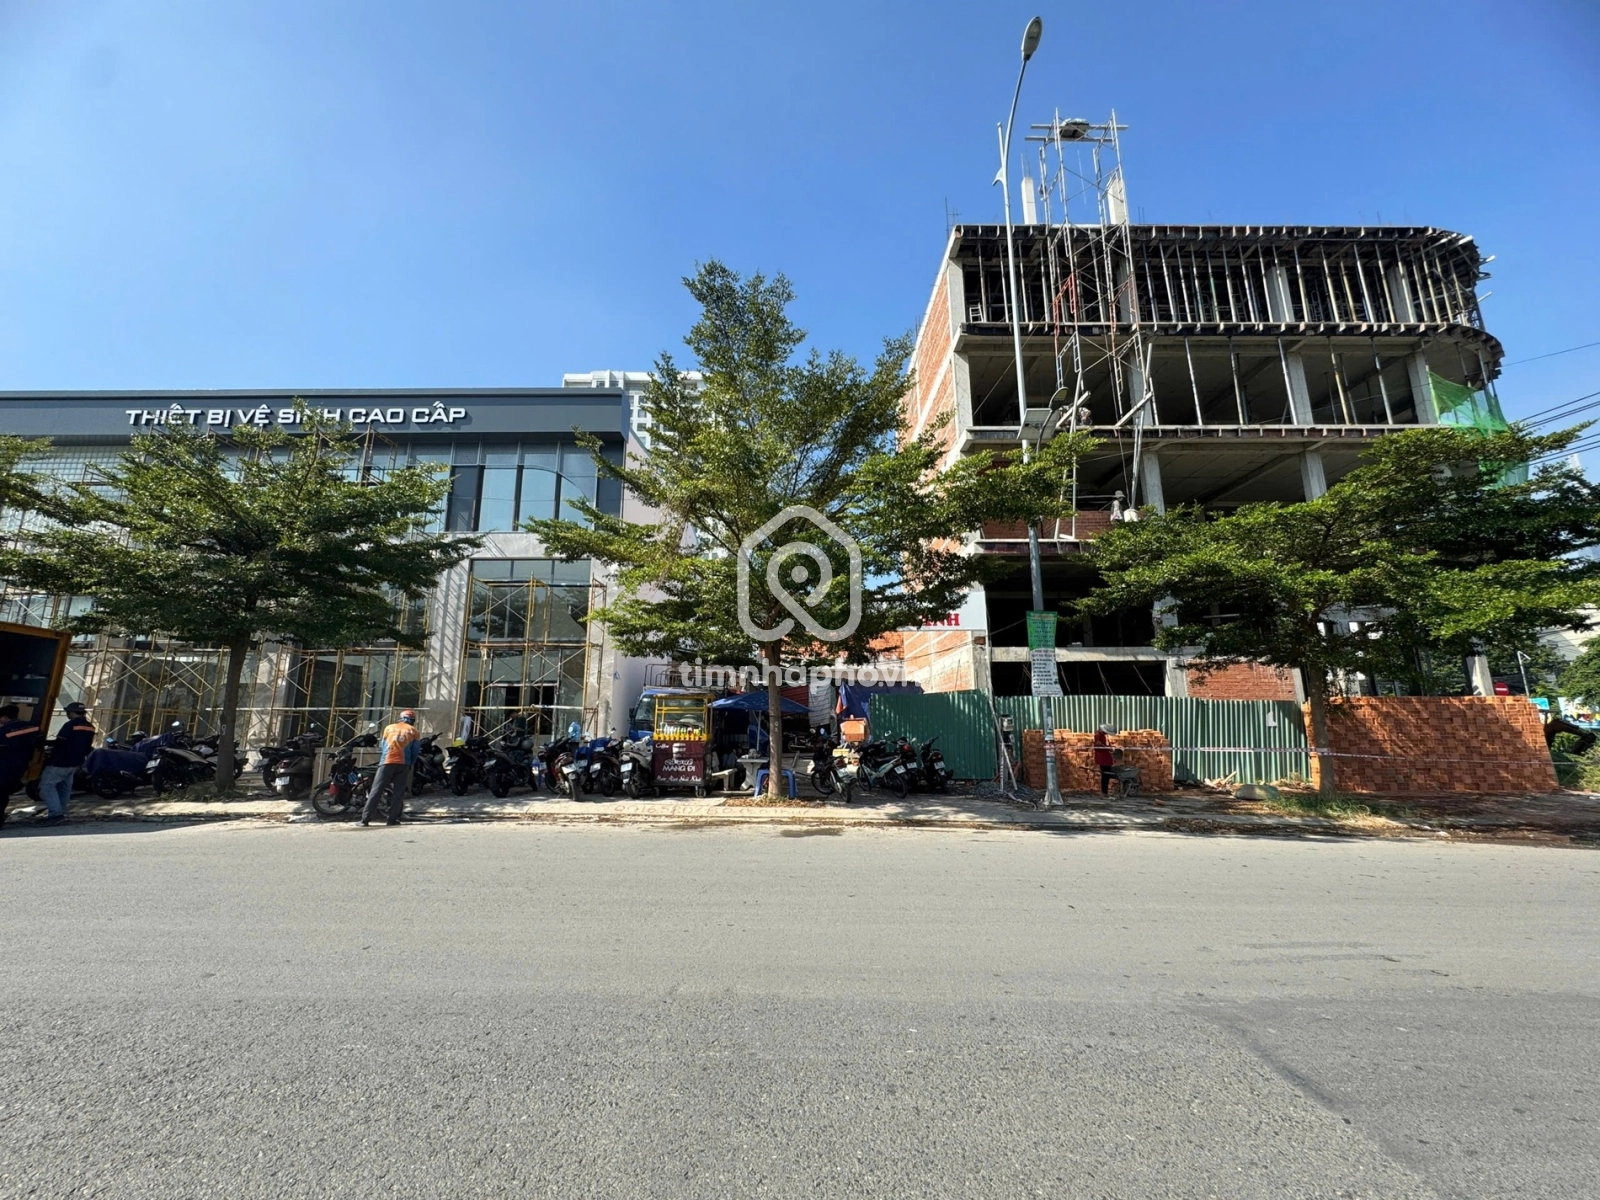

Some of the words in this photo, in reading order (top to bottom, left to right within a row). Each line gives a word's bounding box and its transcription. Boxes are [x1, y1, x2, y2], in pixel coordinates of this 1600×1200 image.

[125, 402, 202, 425] THIẾT
[206, 409, 231, 428] BỊ
[237, 404, 271, 427] VỆ
[348, 408, 404, 423] CAO
[411, 401, 466, 423] CẤP
